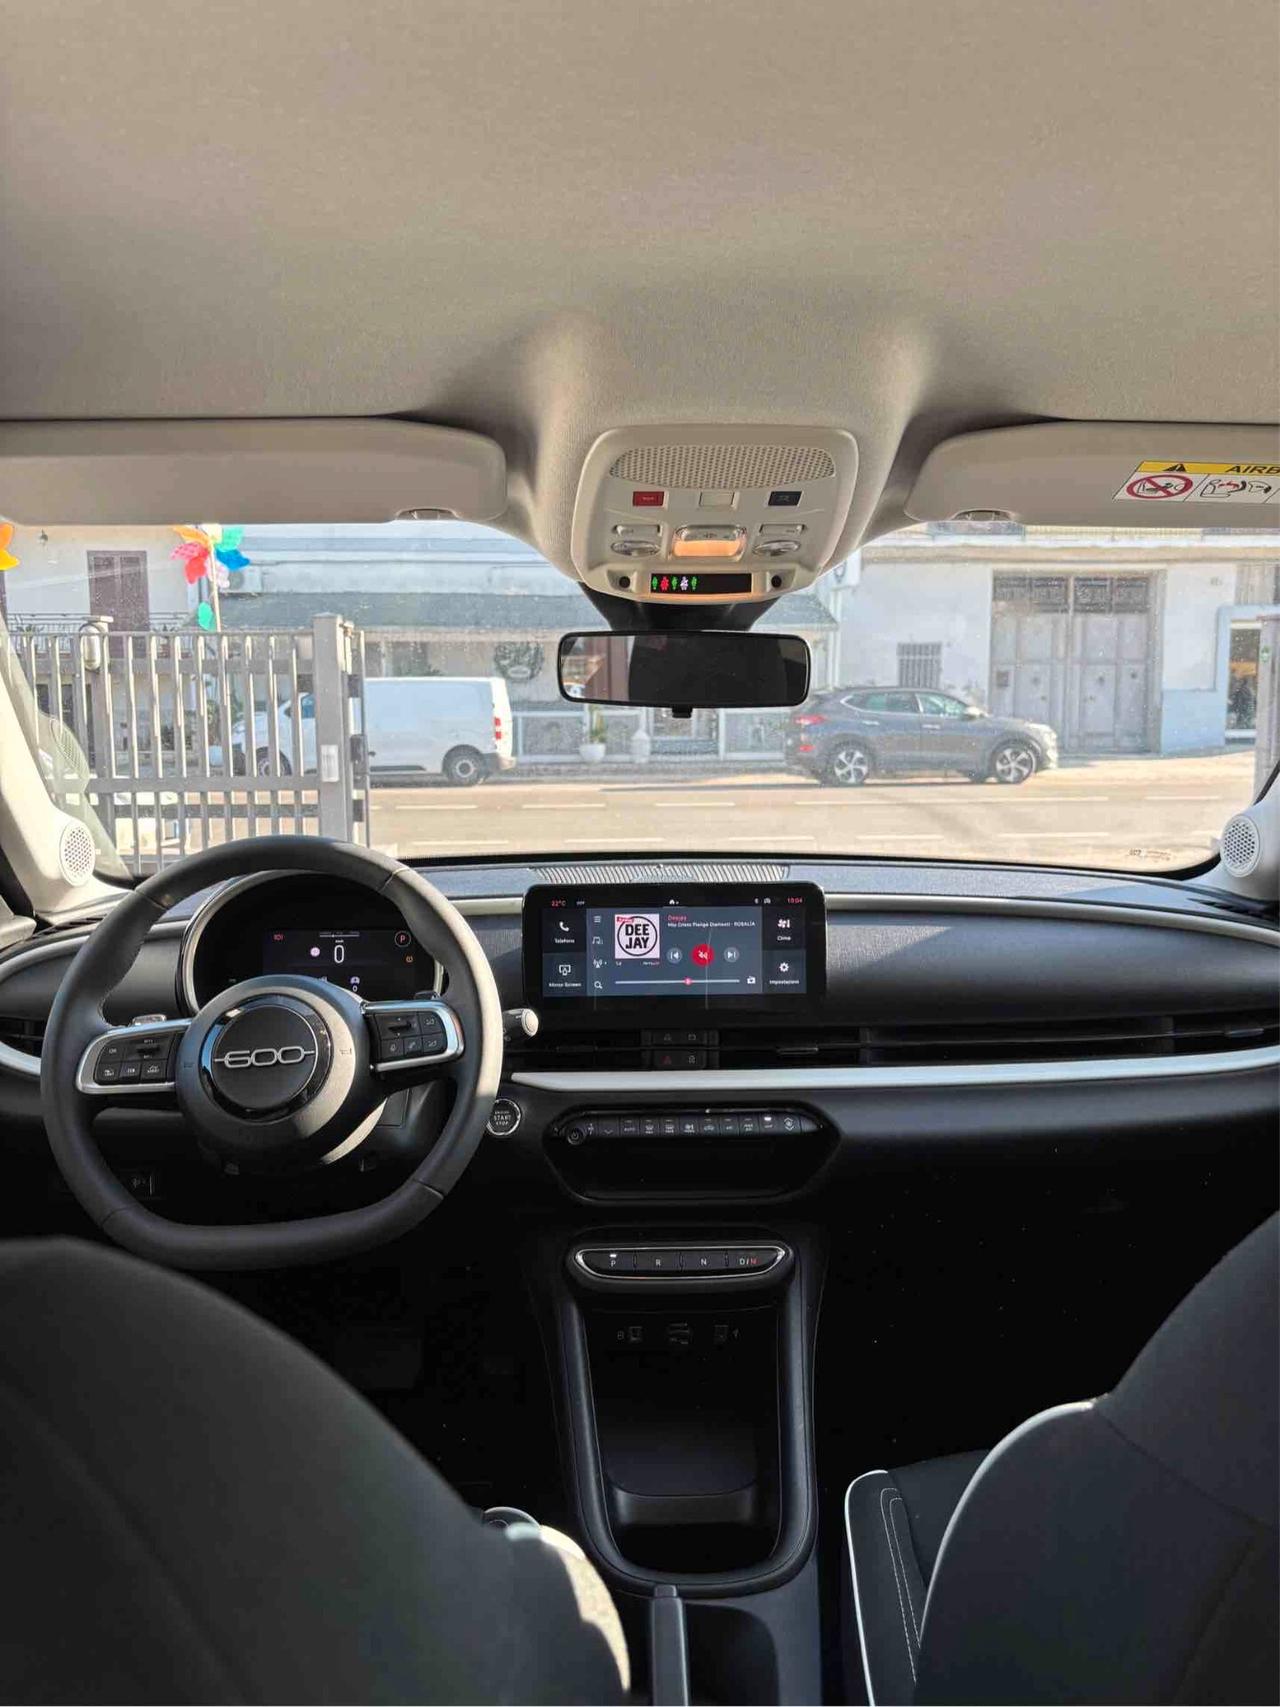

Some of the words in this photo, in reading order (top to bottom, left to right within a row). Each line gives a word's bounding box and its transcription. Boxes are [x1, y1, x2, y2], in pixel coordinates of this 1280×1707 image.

[625, 923, 650, 936] DEE
[625, 937, 650, 949] JAY
[334, 944, 345, 964] 0
[224, 1046, 305, 1068] 600
